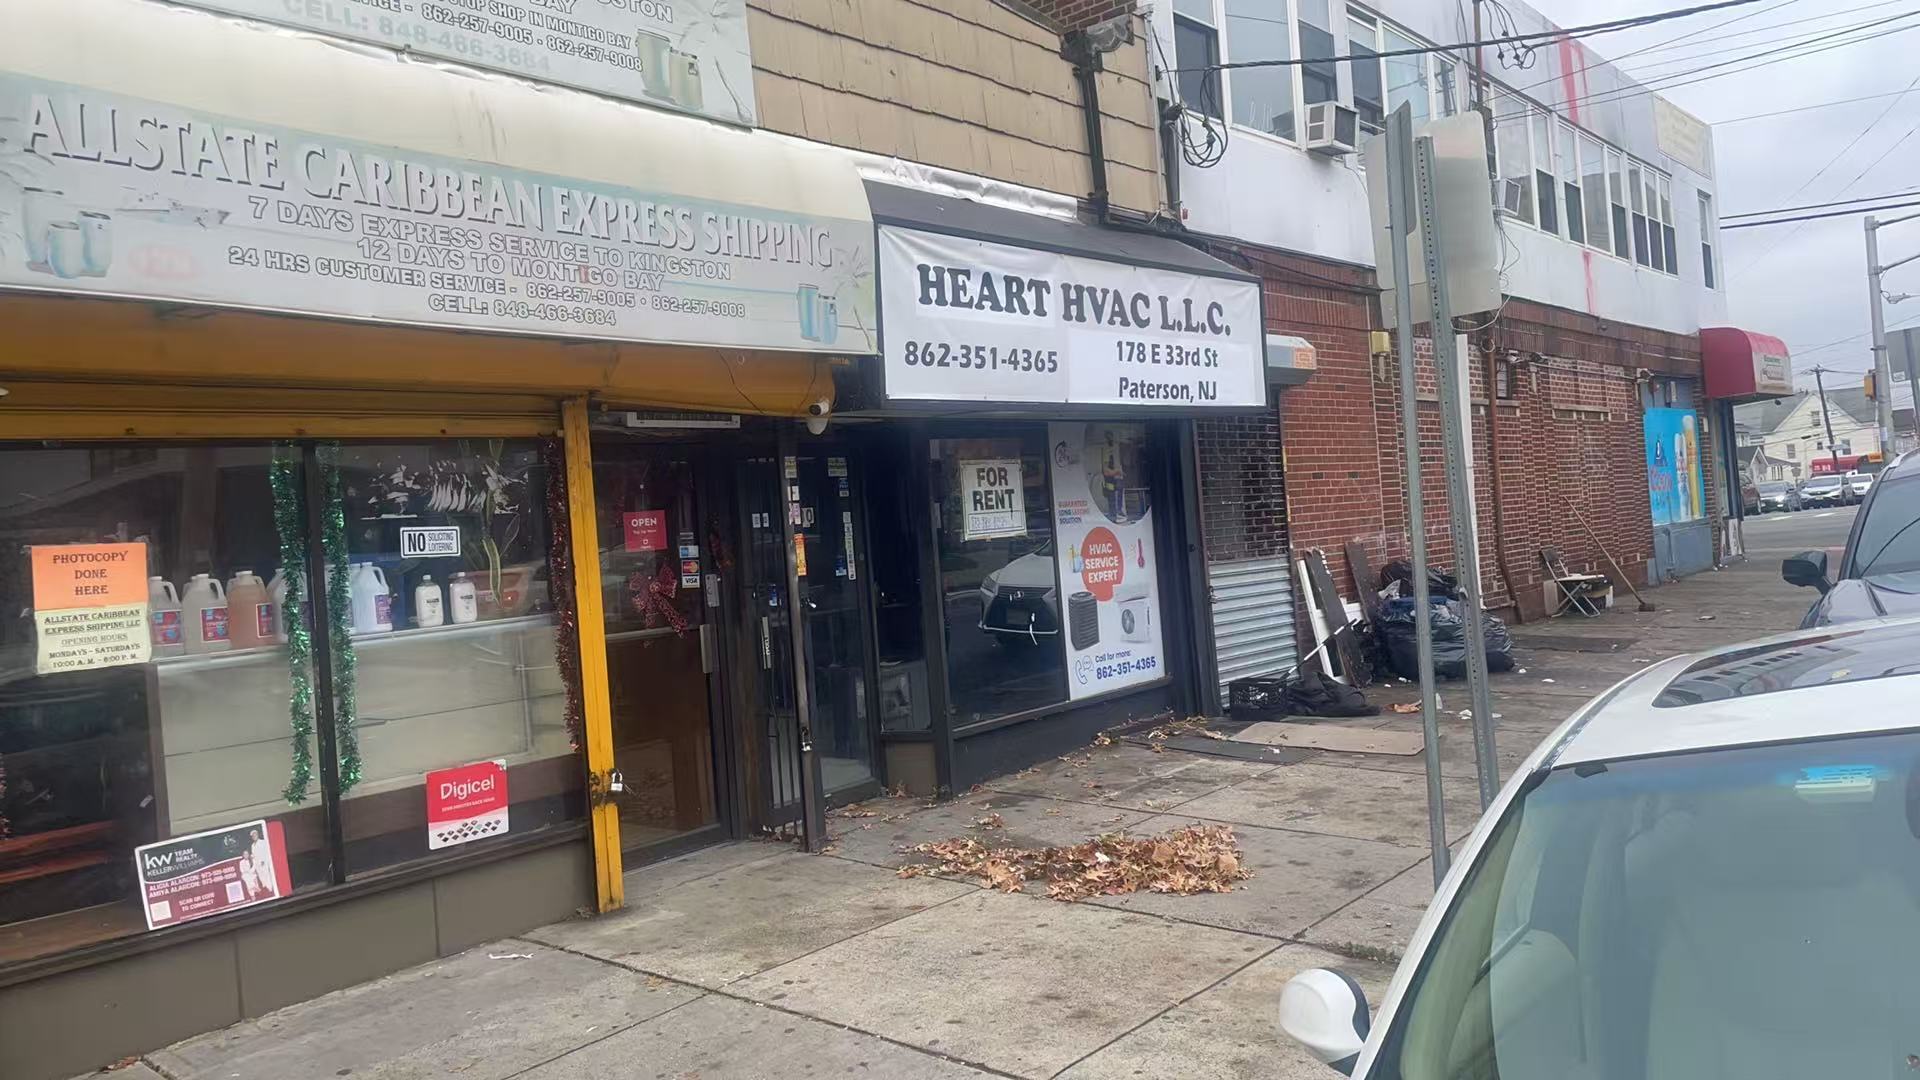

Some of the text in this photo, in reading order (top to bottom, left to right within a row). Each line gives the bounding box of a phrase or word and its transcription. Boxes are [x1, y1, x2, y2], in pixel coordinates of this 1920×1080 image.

[530, 0, 575, 13] AY
[489, 1, 526, 21] SHOP
[529, 11, 544, 27] IN
[546, 15, 604, 43] MONTIGO
[606, 31, 632, 50] BAY
[422, 3, 533, 45] 862-257-9005
[546, 35, 643, 72] 862-257-9008
[24, 94, 833, 268] ALLSTATE CARIBBEAN EXPRESS SHIPPING
[249, 196, 731, 280] 7 DAYS EXPRESS SERVICE TO KINGSTON
[357, 237, 391, 261] 12
[397, 243, 465, 270] DAYS
[471, 253, 505, 275] TO
[624, 271, 664, 291] BAY
[229, 246, 259, 266] 24
[265, 250, 310, 273] HRS
[315, 257, 425, 287] CUSTOMER
[430, 272, 506, 295] SERVICE
[526, 282, 635, 308] 862-257-9005
[652, 296, 745, 317] 862-257-9008
[428, 294, 616, 326] CELL: 848-466-3684
[916, 263, 1231, 336] HEART HVAC L.L.C.
[904, 340, 1058, 373] 862-351-4365
[1117, 341, 1218, 368] 178 E 33rd St
[1118, 376, 1217, 403] Paterson, NJ
[976, 467, 1008, 487] FOR
[972, 489, 1015, 511] RENT
[631, 518, 657, 527] OPEN
[408, 532, 426, 552] NO
[1089, 543, 1113, 555] HVAC
[53, 551, 128, 564] PHOTOCOPY
[1085, 556, 1119, 570] SERVICE
[75, 569, 108, 580] DONE
[1088, 570, 1118, 583] EXPERT
[75, 585, 109, 596] HERE
[44, 613, 90, 624] ALLSTATE
[45, 624, 85, 635] EXPRESS
[86, 621, 125, 632] SHIPPING
[49, 648, 88, 659] MONDAYS
[1096, 656, 1156, 680] 862-351-4365
[440, 774, 495, 800] Digicel
[144, 853, 173, 869] kw
